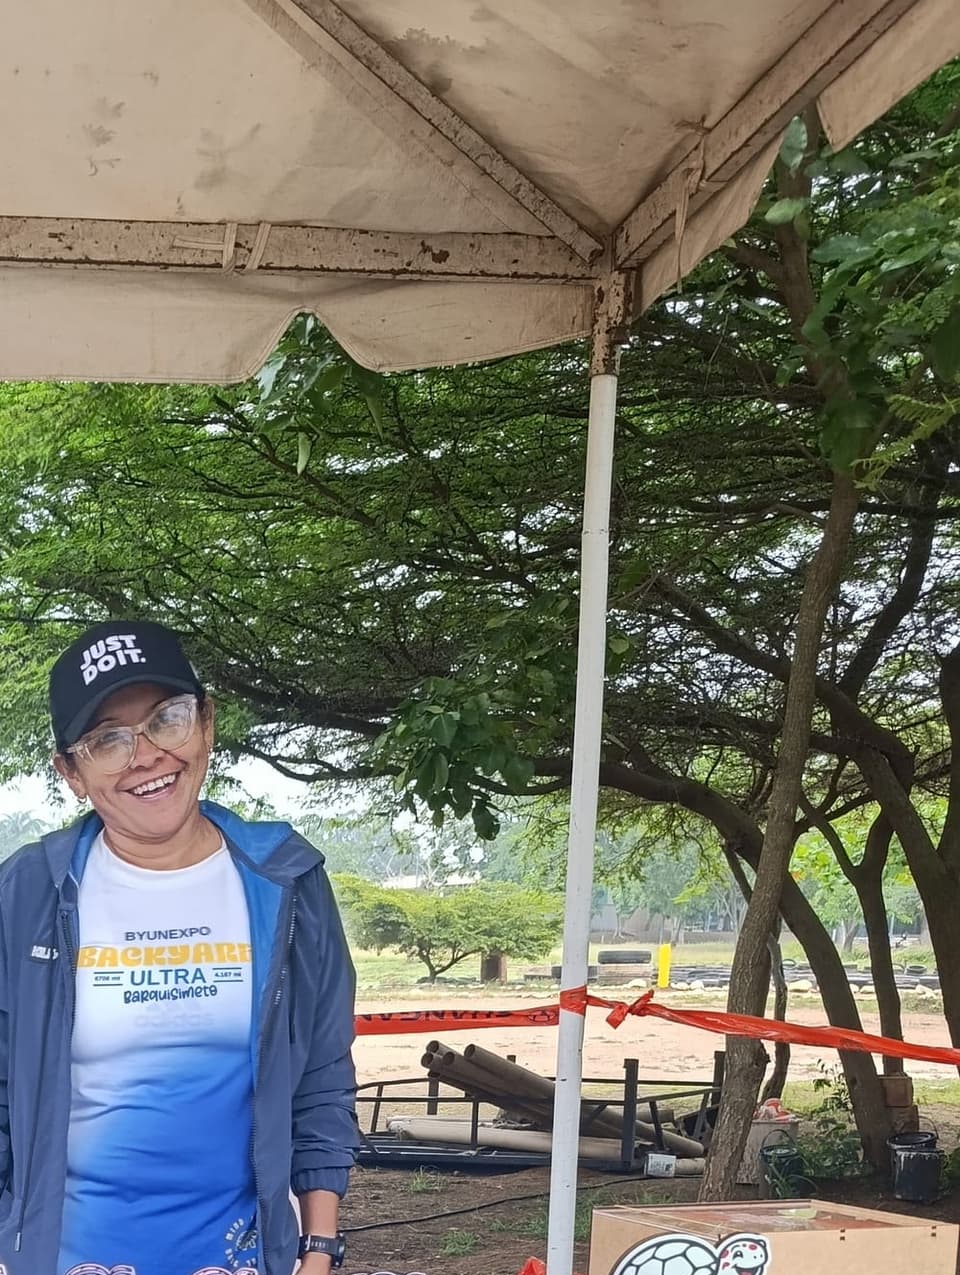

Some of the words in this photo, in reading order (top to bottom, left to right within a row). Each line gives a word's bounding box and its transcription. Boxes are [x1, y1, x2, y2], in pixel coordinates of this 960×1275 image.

[80, 634, 137, 671] JUST
[82, 654, 116, 686] DO
[124, 926, 211, 942] BYUNEXPO
[130, 967, 207, 986] ULTRA
